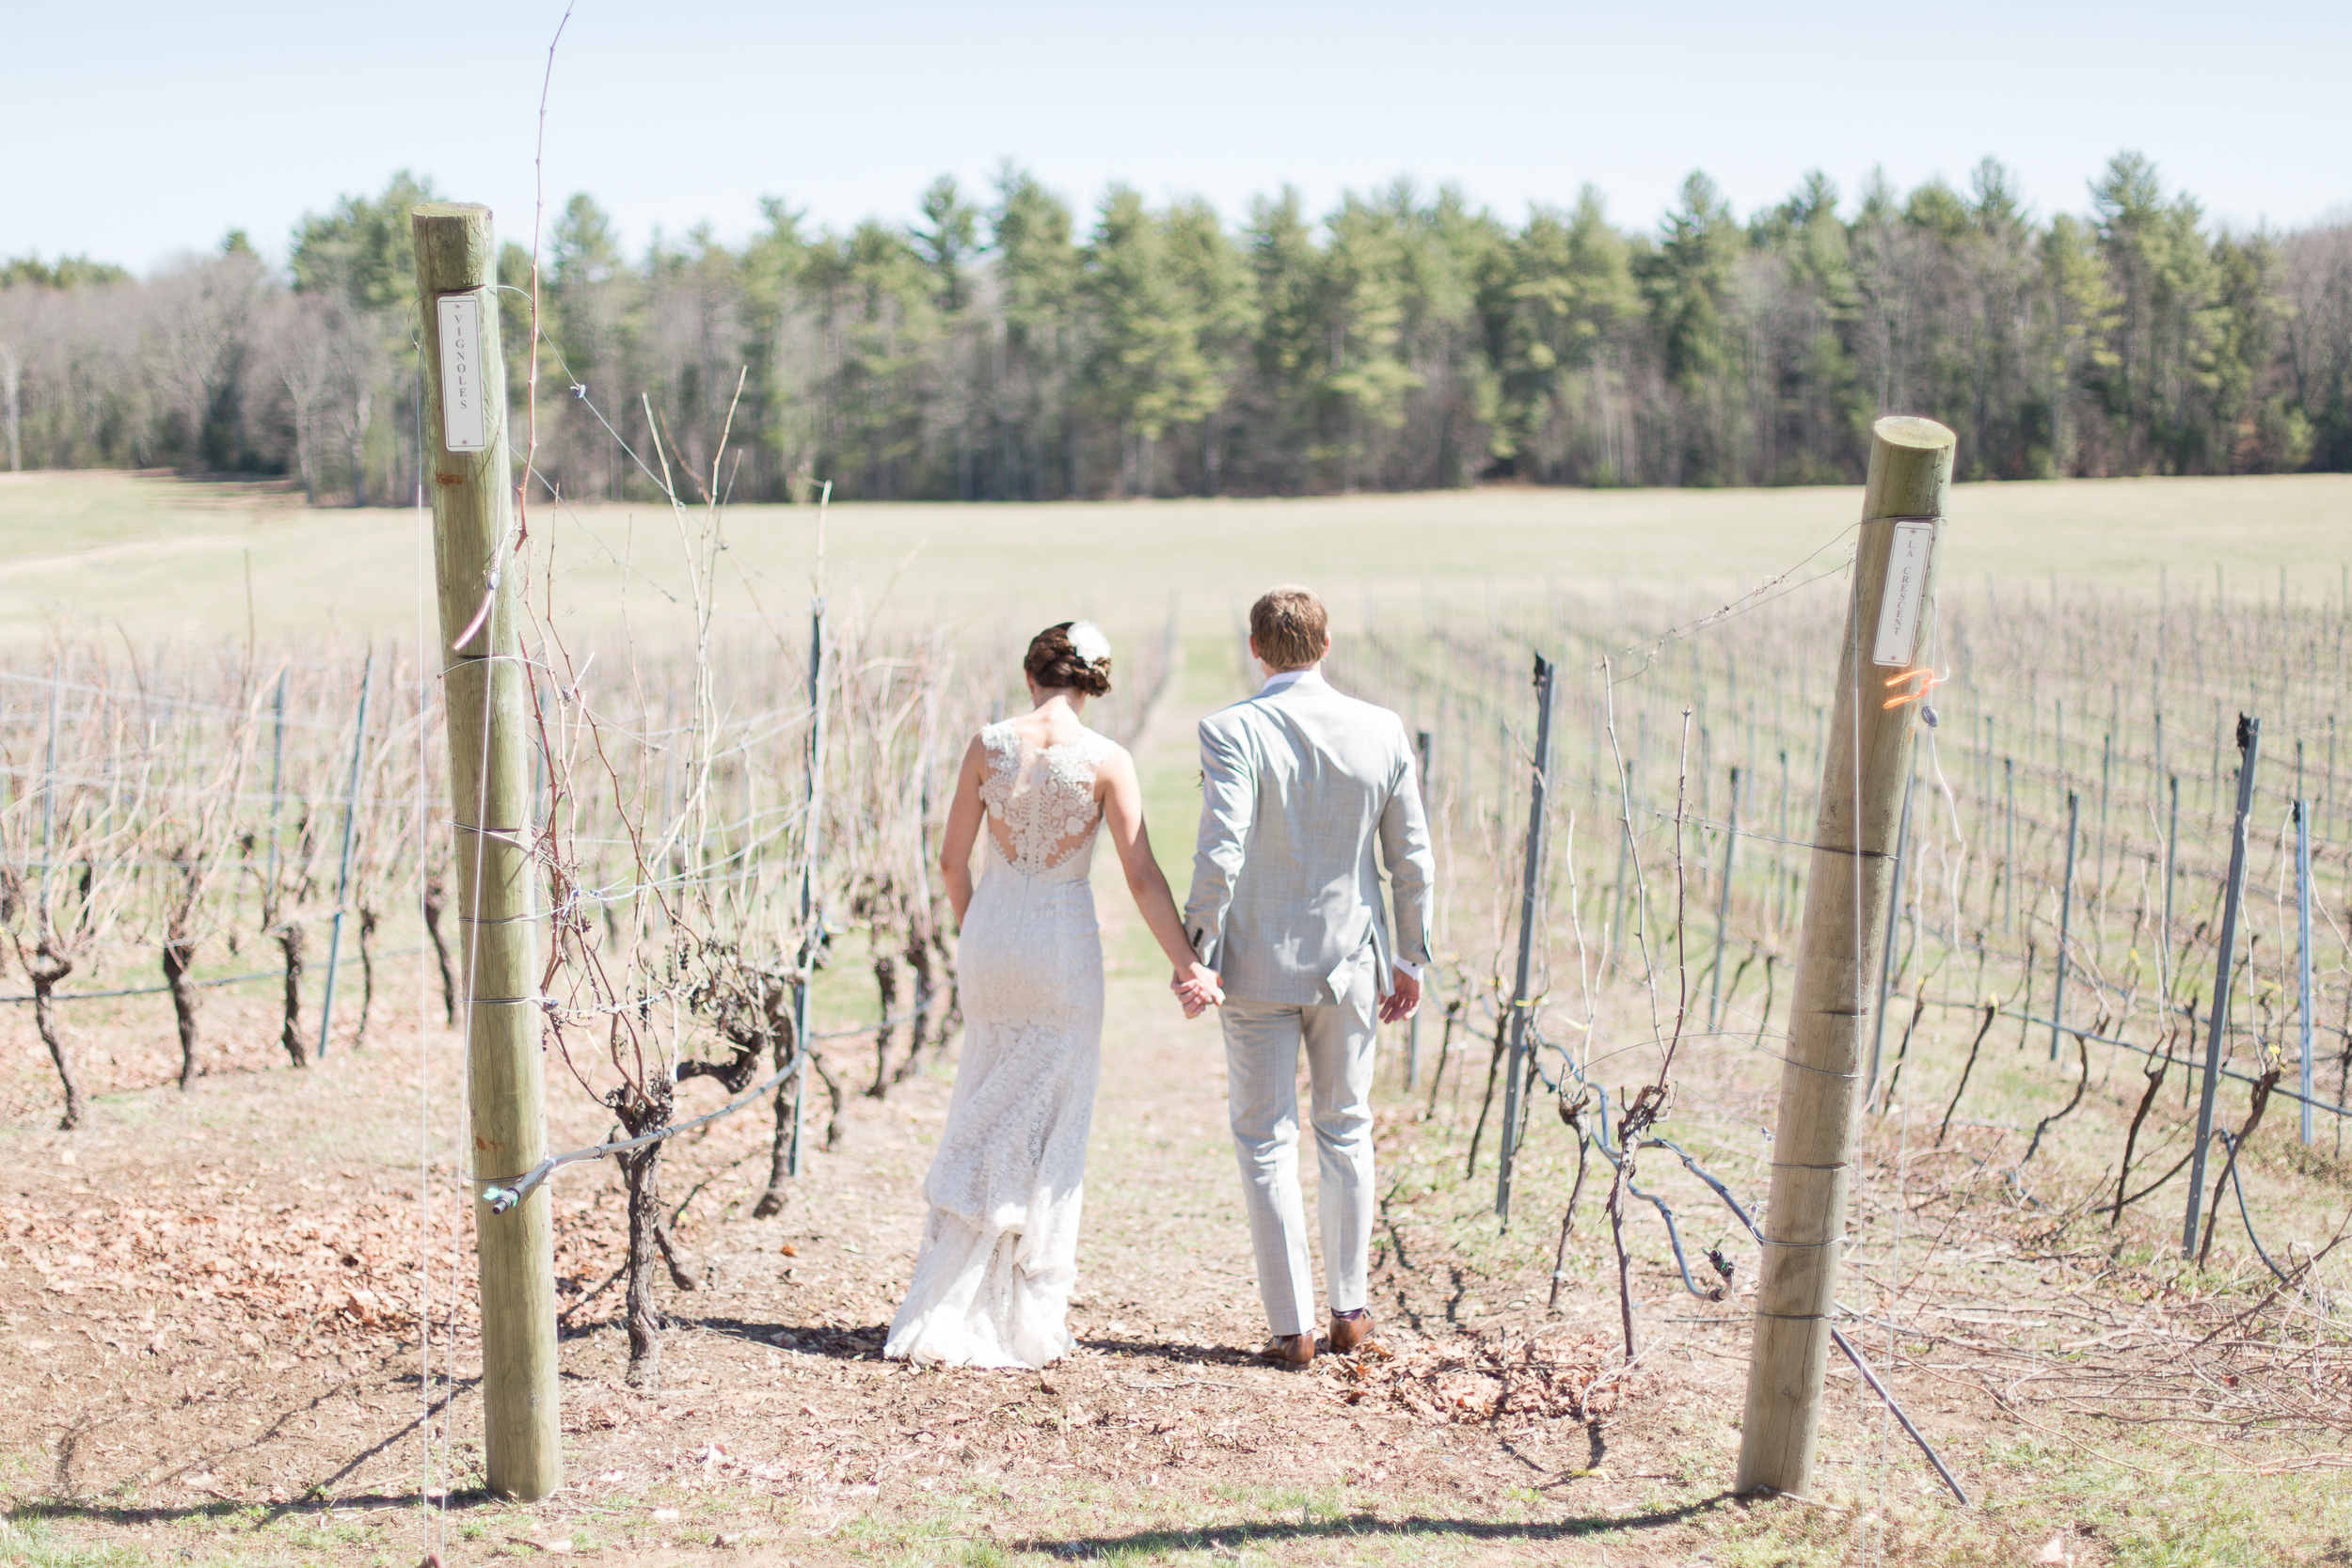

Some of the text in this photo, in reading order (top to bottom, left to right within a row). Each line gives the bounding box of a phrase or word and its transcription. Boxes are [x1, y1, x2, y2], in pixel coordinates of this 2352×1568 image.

[453, 314, 468, 410] VIGNOLES
[1893, 540, 1915, 636] LA CRESCENT
